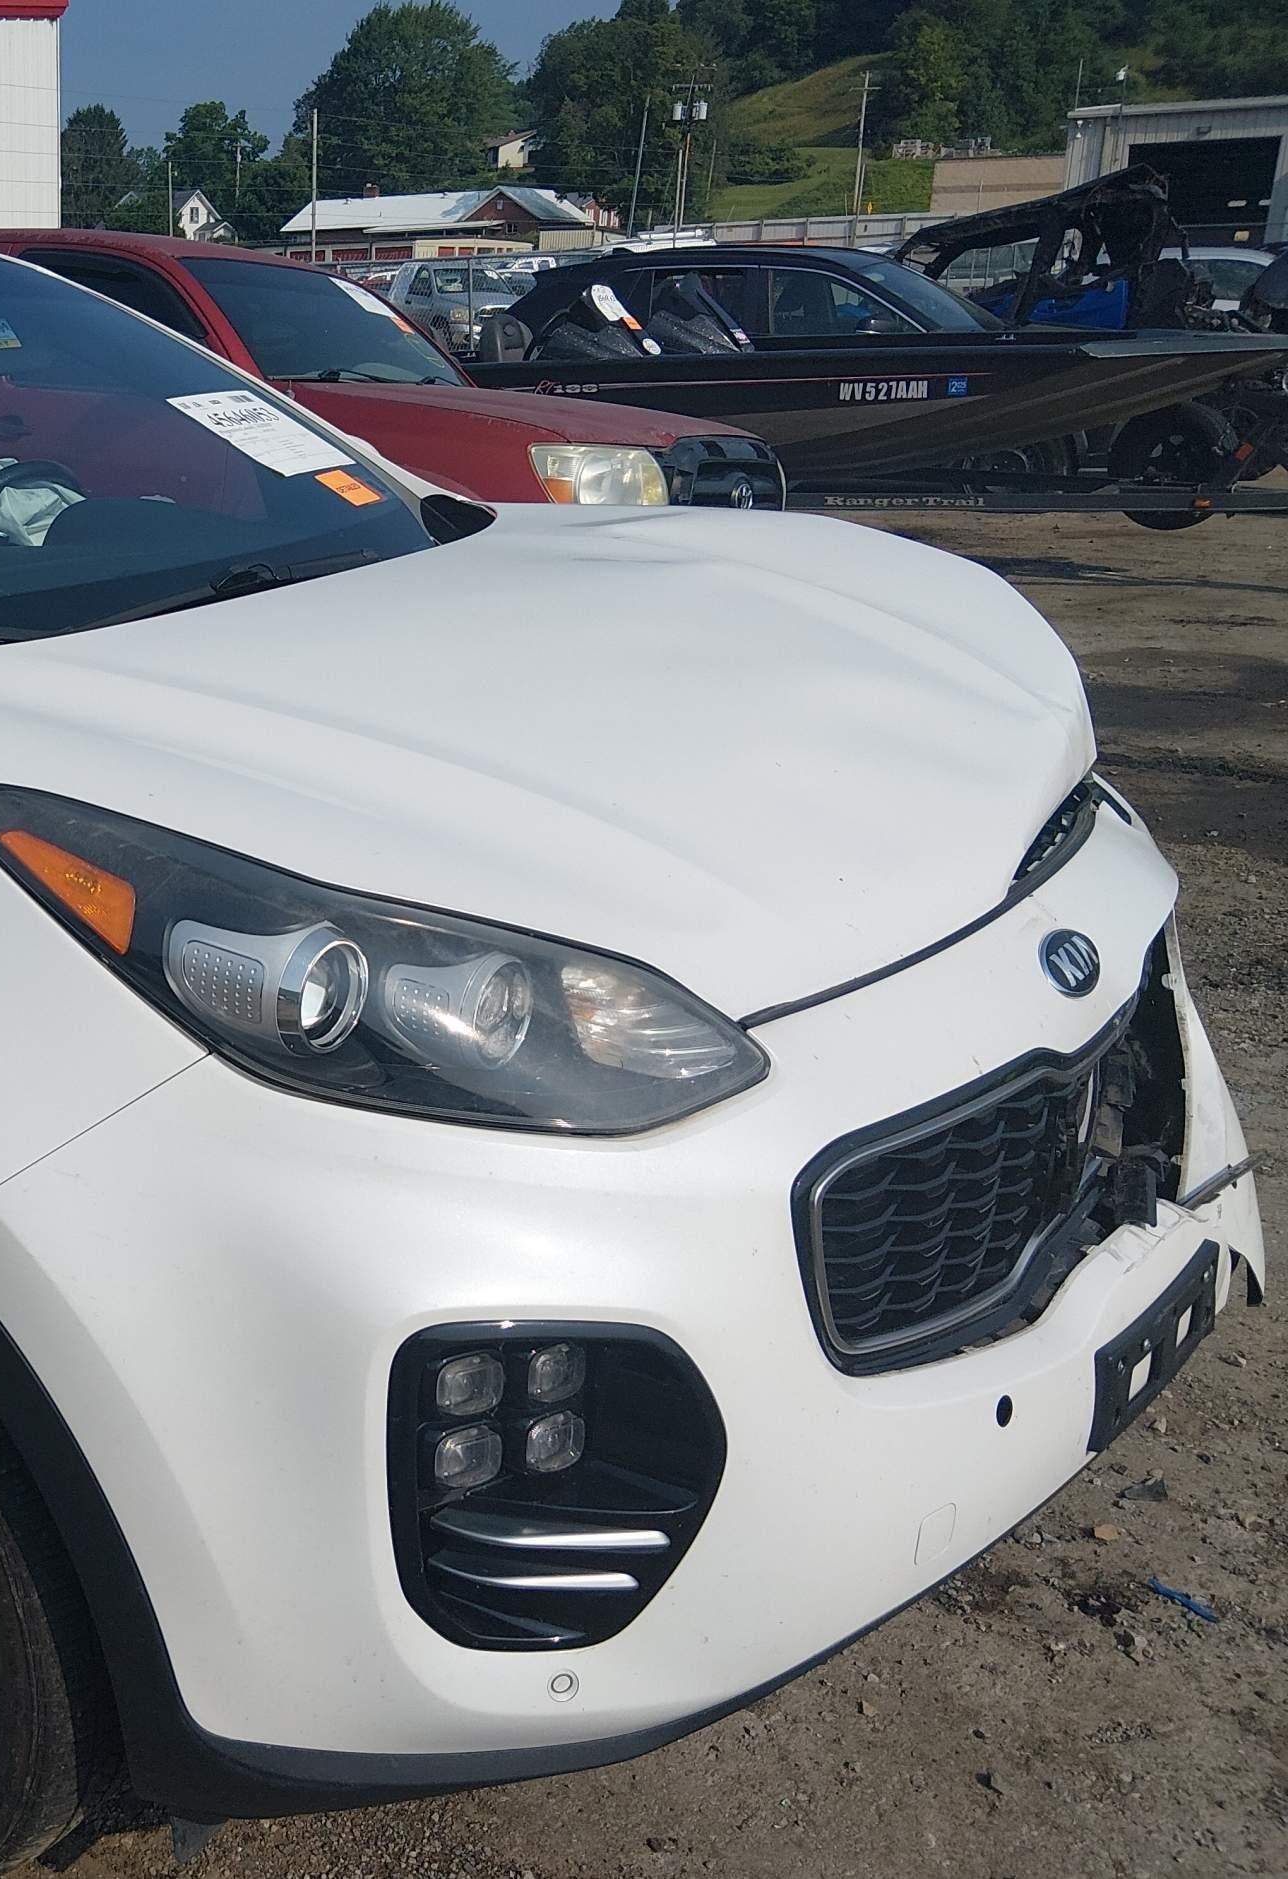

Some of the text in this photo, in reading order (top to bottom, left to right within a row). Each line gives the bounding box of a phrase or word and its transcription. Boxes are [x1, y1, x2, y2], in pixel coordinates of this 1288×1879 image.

[206, 407, 280, 428] 45646053
[824, 495, 986, 507] Ranger Trail
[1048, 935, 1099, 987] KIA
